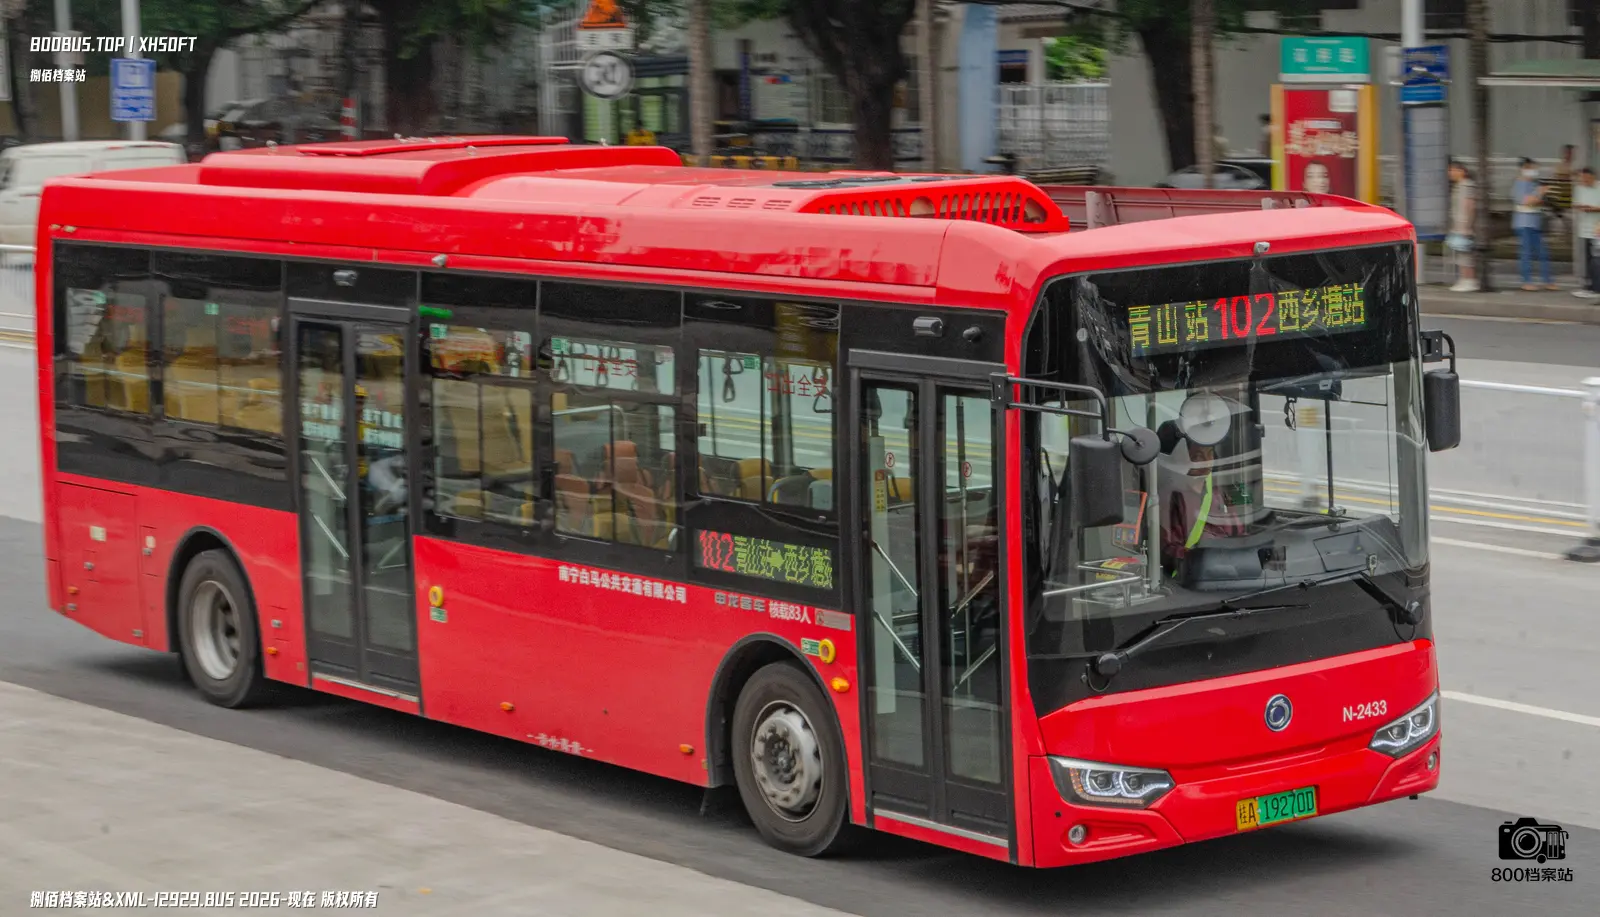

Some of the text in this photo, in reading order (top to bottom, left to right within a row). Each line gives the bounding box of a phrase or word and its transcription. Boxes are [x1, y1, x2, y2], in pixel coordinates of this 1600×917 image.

[1128, 282, 1365, 349] 青山站 102 西乡塘站
[700, 530, 735, 572] 102
[558, 565, 687, 604] 南宁白马公共交通有限公司
[768, 599, 812, 624] 核载83人
[1343, 699, 1387, 722] N-2433
[1263, 790, 1315, 820] 19270D
